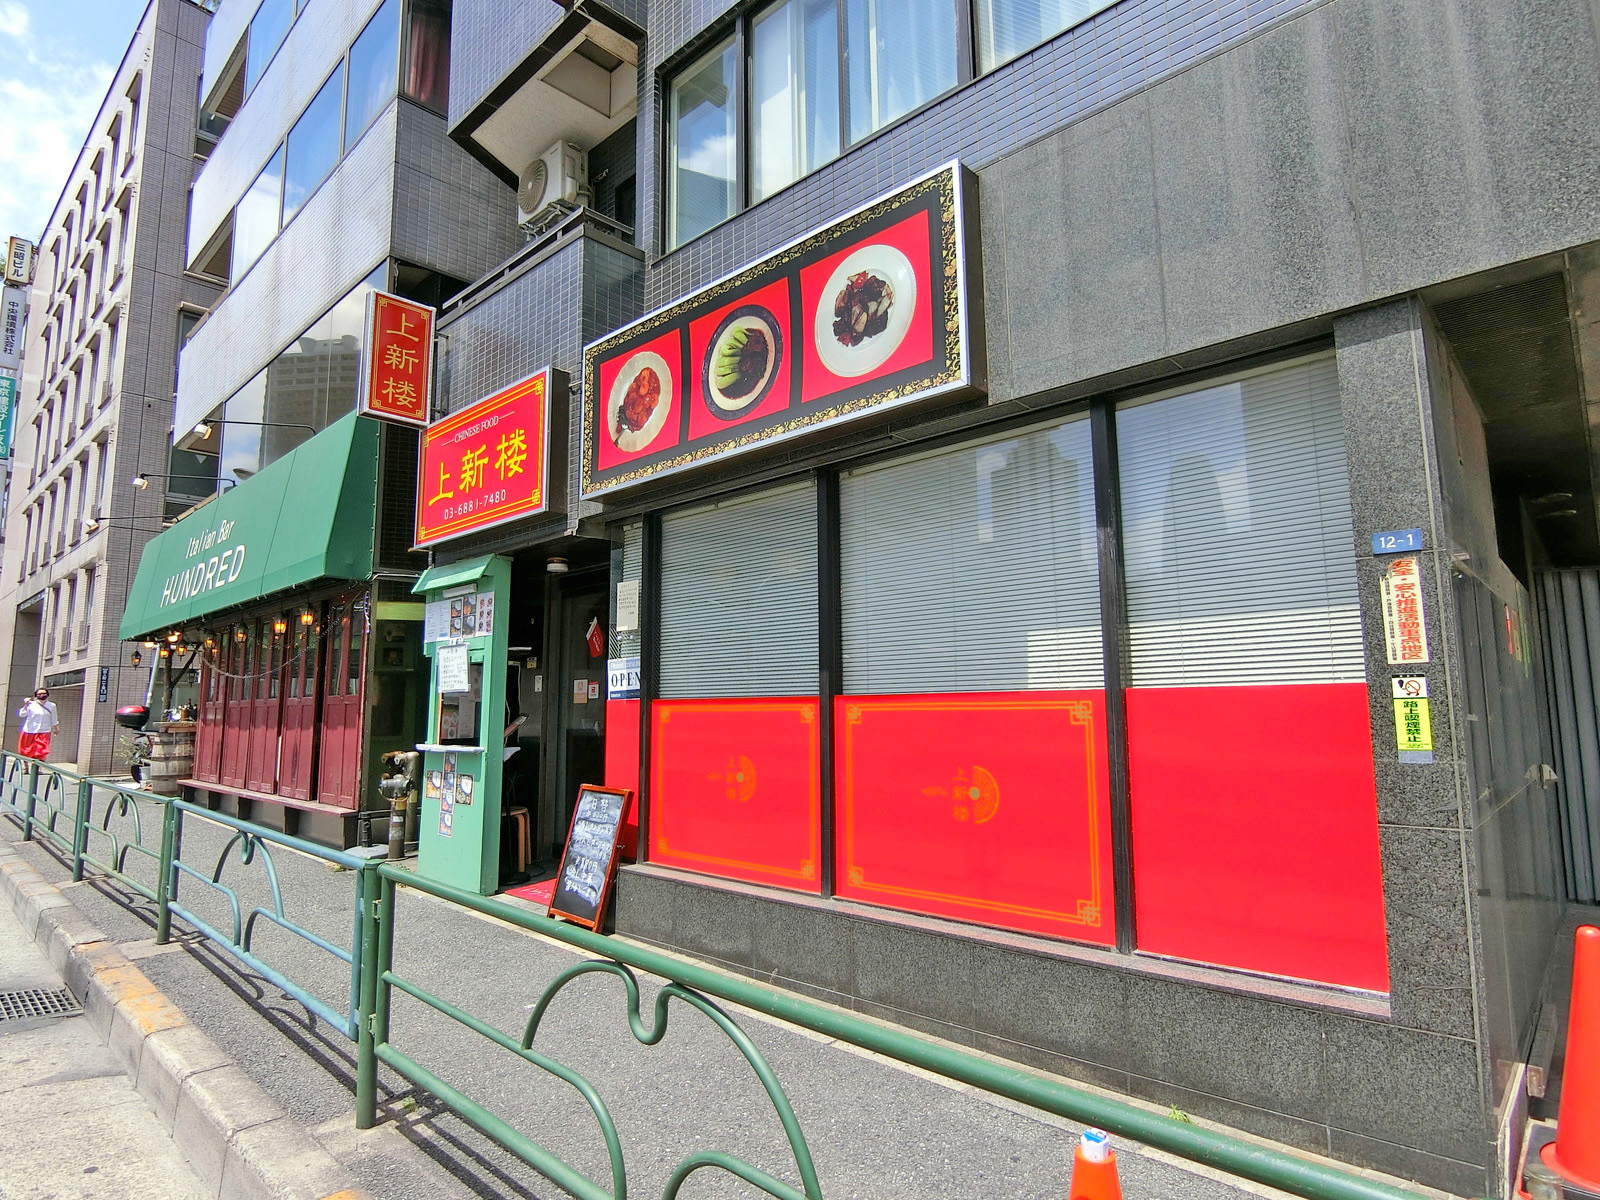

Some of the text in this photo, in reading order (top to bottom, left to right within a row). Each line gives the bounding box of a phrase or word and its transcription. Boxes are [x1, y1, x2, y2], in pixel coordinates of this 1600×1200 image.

[11, 242, 26, 278] 三昭ビル
[3, 301, 19, 356] 中央環境株式会社
[382, 313, 420, 408] 上新楼
[453, 415, 499, 444] CHINESE FOOD
[428, 428, 528, 507] 上新楼
[443, 489, 507, 521] 03-6881-7480
[185, 519, 236, 560] Italian Bar
[1379, 533, 1414, 549] 12-1
[160, 544, 247, 608] HUNDRED
[1403, 701, 1422, 743] 路上喫煙禁止
